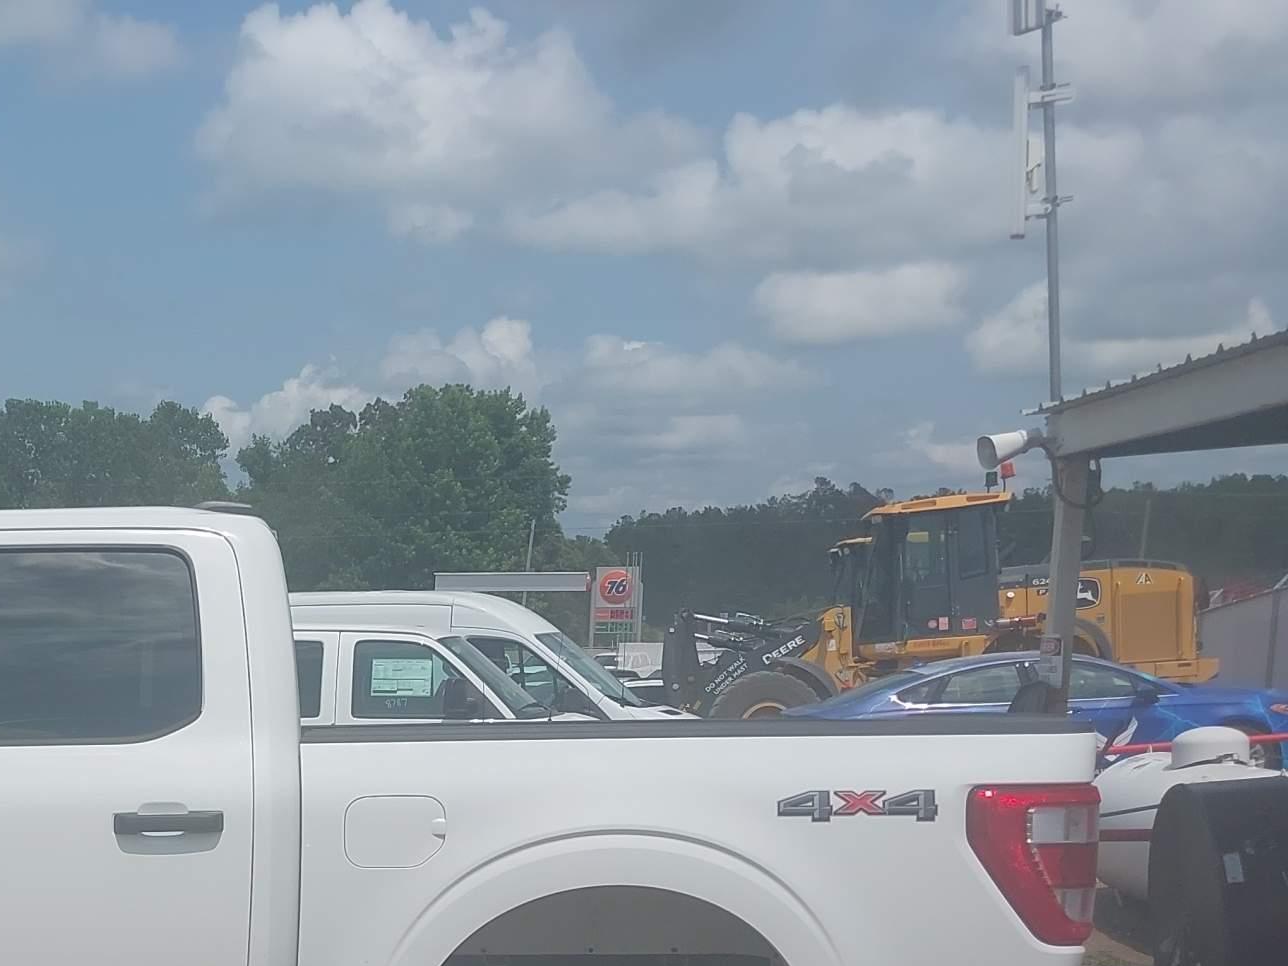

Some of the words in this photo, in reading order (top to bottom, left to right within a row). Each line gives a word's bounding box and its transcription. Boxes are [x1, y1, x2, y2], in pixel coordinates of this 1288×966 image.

[605, 577, 628, 596] 76
[762, 635, 806, 665] DEERE
[713, 676, 734, 695] UNDER
[732, 662, 749, 679] MAST
[714, 669, 729, 684] NOT
[728, 655, 746, 672] WALK
